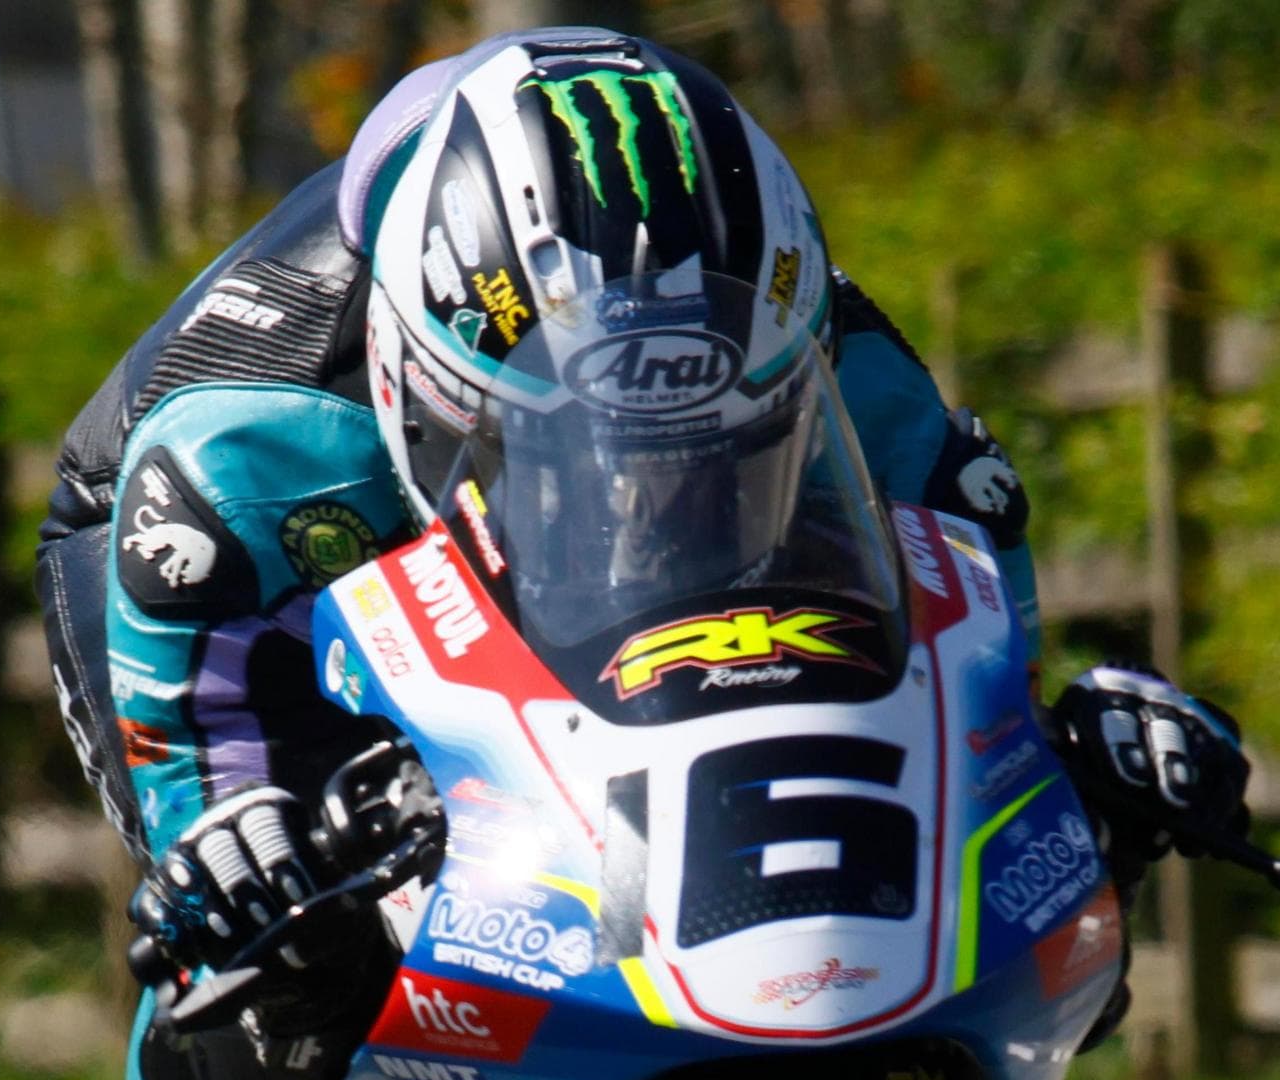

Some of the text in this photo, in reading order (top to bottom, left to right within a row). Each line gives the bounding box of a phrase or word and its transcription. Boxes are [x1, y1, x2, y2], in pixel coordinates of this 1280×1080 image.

[489, 267, 530, 327] TNC
[591, 340, 725, 391] Arai
[399, 533, 490, 660] MOTUL
[606, 607, 870, 696] RK
[698, 666, 803, 692] Racing
[600, 733, 920, 965] 16
[429, 892, 596, 977] Moto4
[433, 942, 565, 990] BRITISH CUP
[401, 976, 491, 1037] htc
